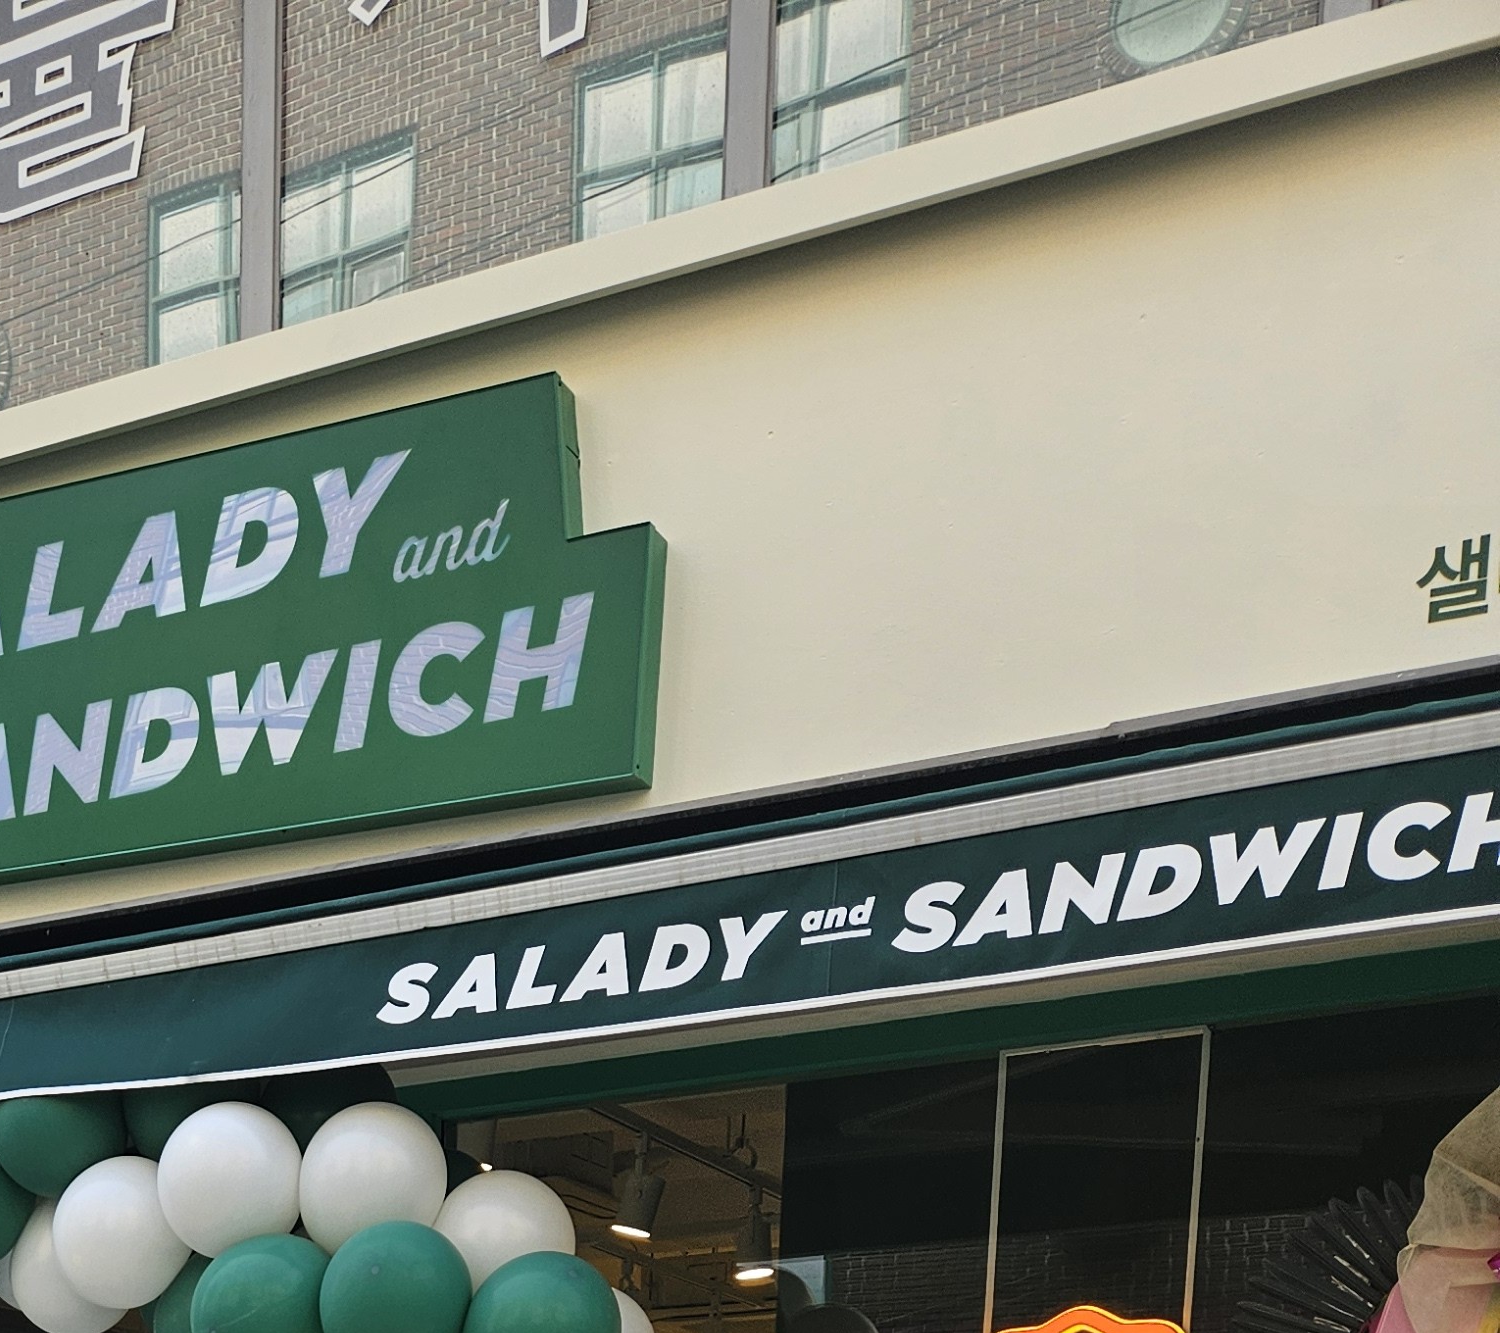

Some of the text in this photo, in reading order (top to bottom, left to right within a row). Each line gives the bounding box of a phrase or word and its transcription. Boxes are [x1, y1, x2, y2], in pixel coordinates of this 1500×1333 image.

[393, 498, 510, 583] and
[376, 910, 788, 1024] SALADY
[800, 896, 876, 934] and
